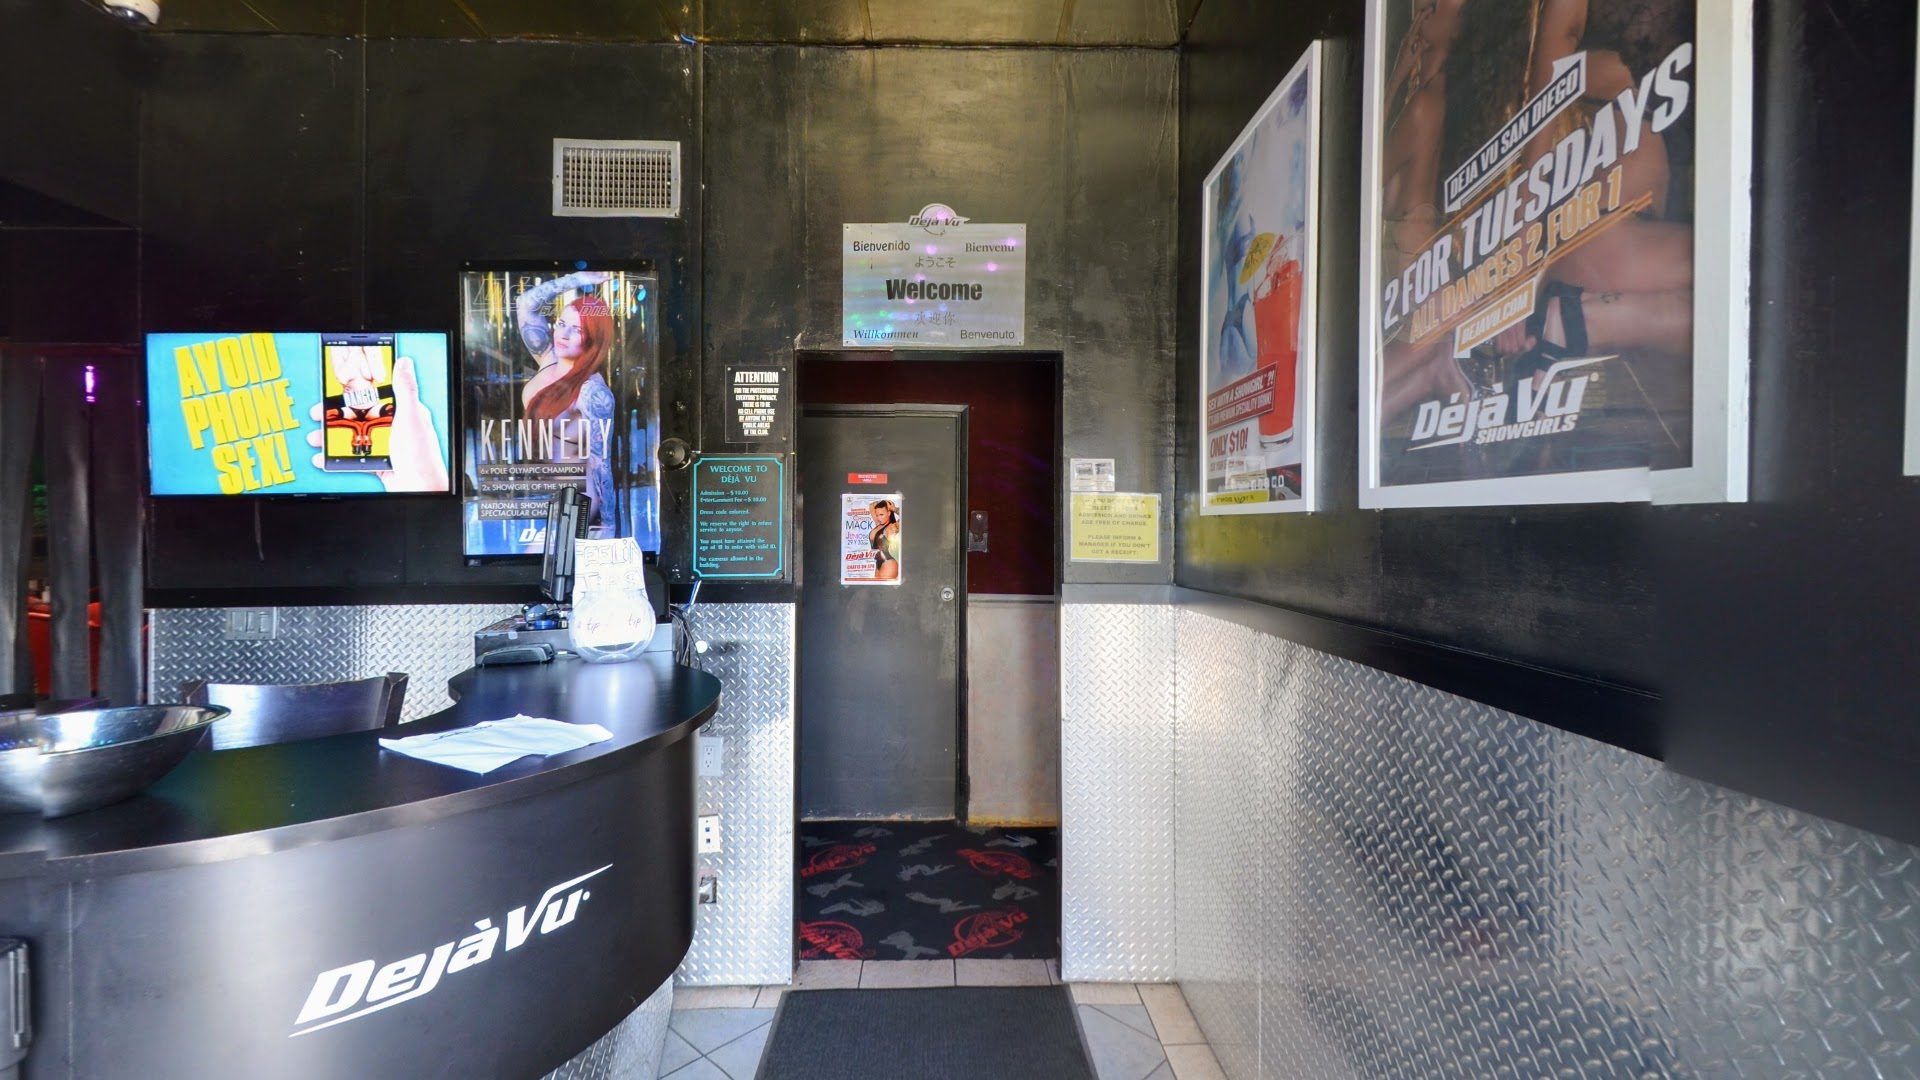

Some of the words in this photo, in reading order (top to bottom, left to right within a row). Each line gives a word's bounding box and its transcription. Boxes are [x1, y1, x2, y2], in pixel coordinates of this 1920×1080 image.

[1450, 159, 1479, 200] DEJA
[1480, 139, 1499, 171] VU
[1500, 110, 1529, 154] SAN
[1531, 66, 1579, 127] DIEGO
[1384, 278, 1399, 330] 2
[1402, 234, 1452, 316] FOR
[1461, 42, 1693, 270] TUESDAYS
[853, 241, 910, 252] Bienvenido
[965, 242, 1015, 253] Bienvenu
[1410, 298, 1440, 344] ALL
[1441, 237, 1523, 322] DANCES
[1526, 222, 1543, 266] 2
[1547, 181, 1602, 252] FOR
[1607, 164, 1622, 212] 1
[915, 256, 956, 269] ようこそ
[886, 279, 983, 301] Welcome
[853, 329, 919, 339] Willkommen
[960, 329, 1015, 340] Benvenuto
[174, 333, 282, 398] AVOID
[734, 372, 779, 383] ATTENTION
[181, 379, 300, 449] PHONE
[1409, 382, 1509, 448] Déjà
[1517, 359, 1602, 423] Vu
[481, 418, 612, 461] KENNEDY
[1476, 414, 1578, 444] SHOWGIRLS
[1210, 432, 1227, 458] ONLY
[1229, 427, 1249, 455] $10!
[212, 432, 296, 494] SEX!
[490, 466, 507, 475] POLE
[509, 466, 540, 475] OLYMPIC
[542, 466, 584, 474] CHAMPION
[710, 465, 751, 473] WELCOME
[756, 465, 767, 473] TO
[745, 475, 757, 483] VU
[481, 502, 518, 510] NATIONAL
[481, 509, 530, 517] SPECTACULAR
[846, 520, 873, 530] MACK
[290, 918, 500, 1037] Dejà
[505, 868, 598, 951] Vu
